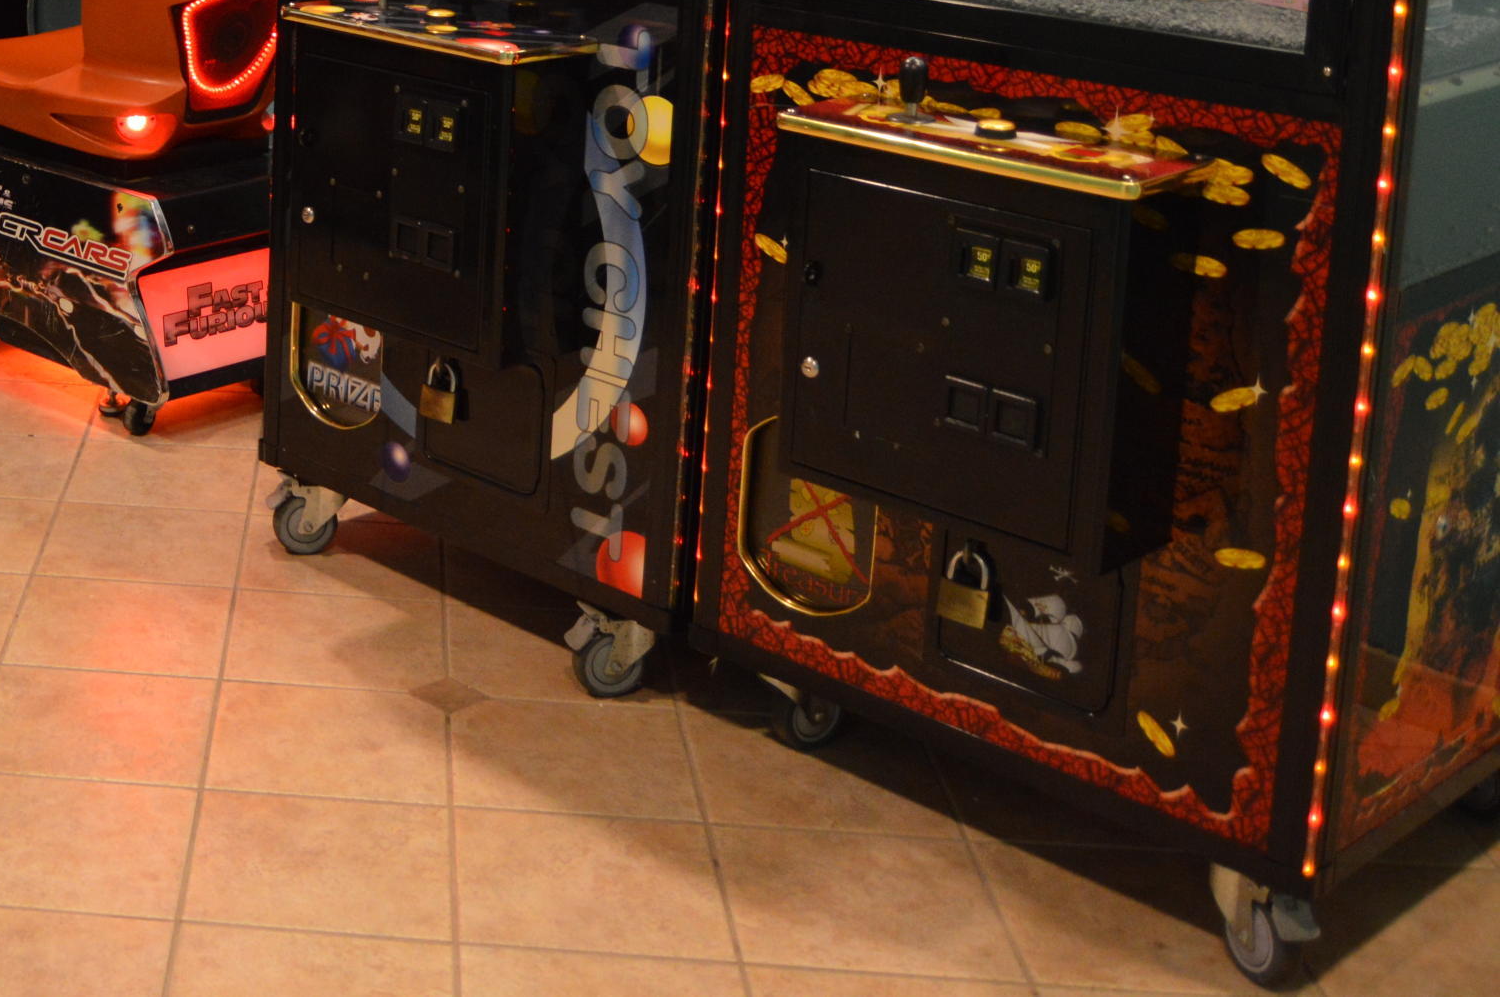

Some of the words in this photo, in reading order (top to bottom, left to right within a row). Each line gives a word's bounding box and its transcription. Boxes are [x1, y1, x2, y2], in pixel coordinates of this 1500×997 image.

[584, 29, 652, 222] TOY
[3, 188, 12, 197] &
[187, 281, 264, 316] FAST
[163, 301, 268, 348] FURIOU
[570, 241, 641, 561] CHEST
